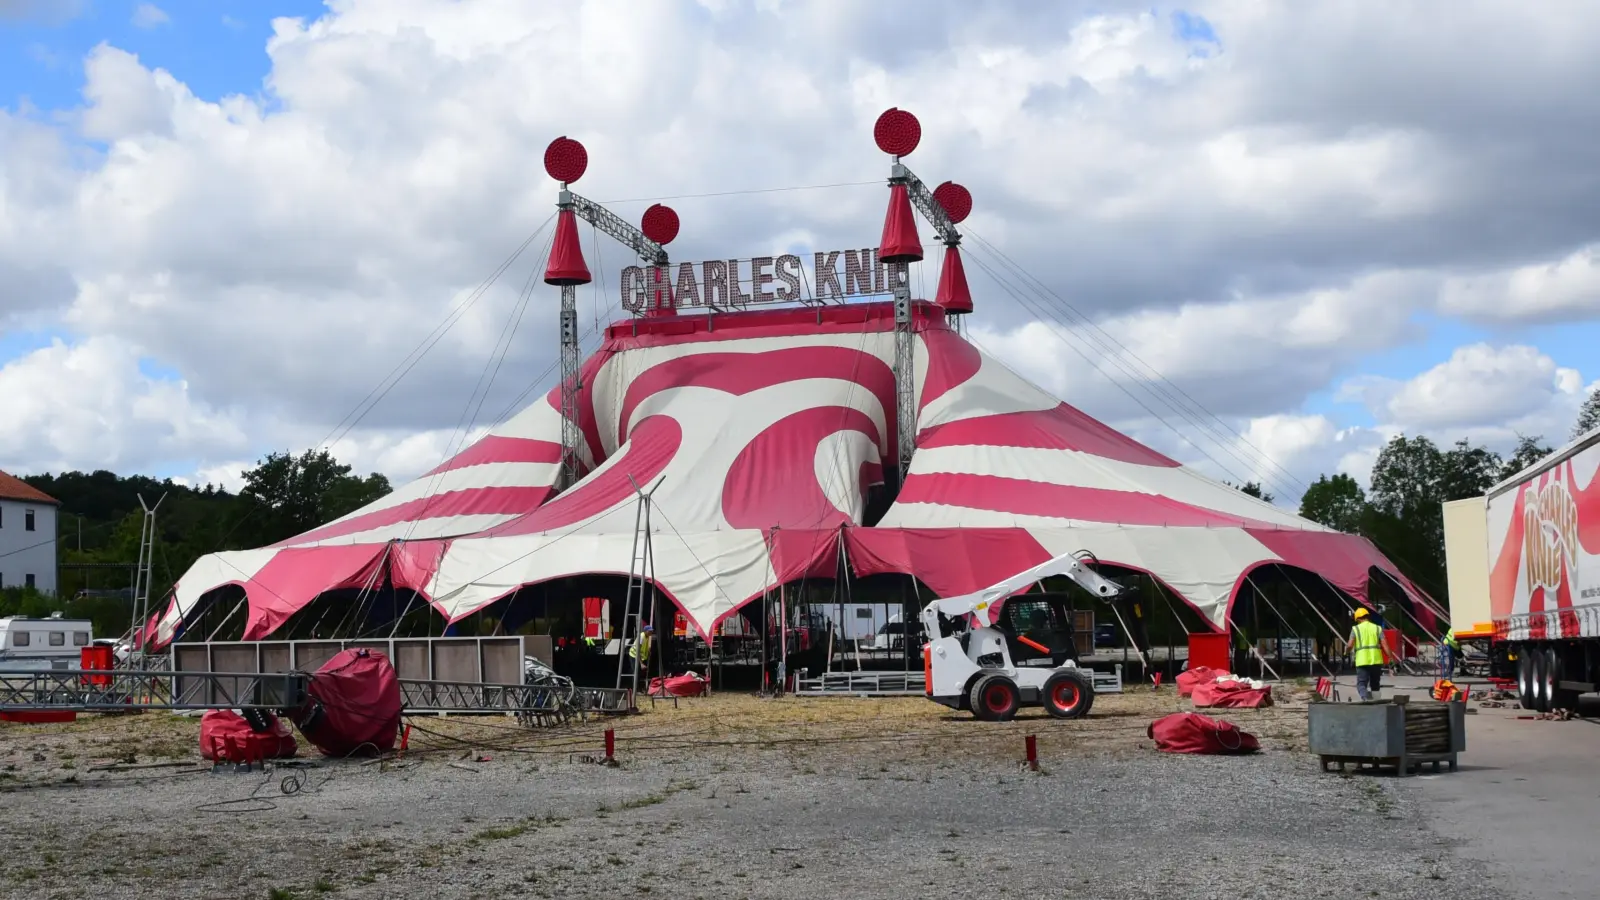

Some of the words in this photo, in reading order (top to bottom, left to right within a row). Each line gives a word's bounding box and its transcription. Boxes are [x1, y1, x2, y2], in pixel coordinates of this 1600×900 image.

[621, 254, 800, 313] CHARLES
[1524, 509, 1561, 596] KNIE
[1540, 484, 1578, 568] CHARLES
